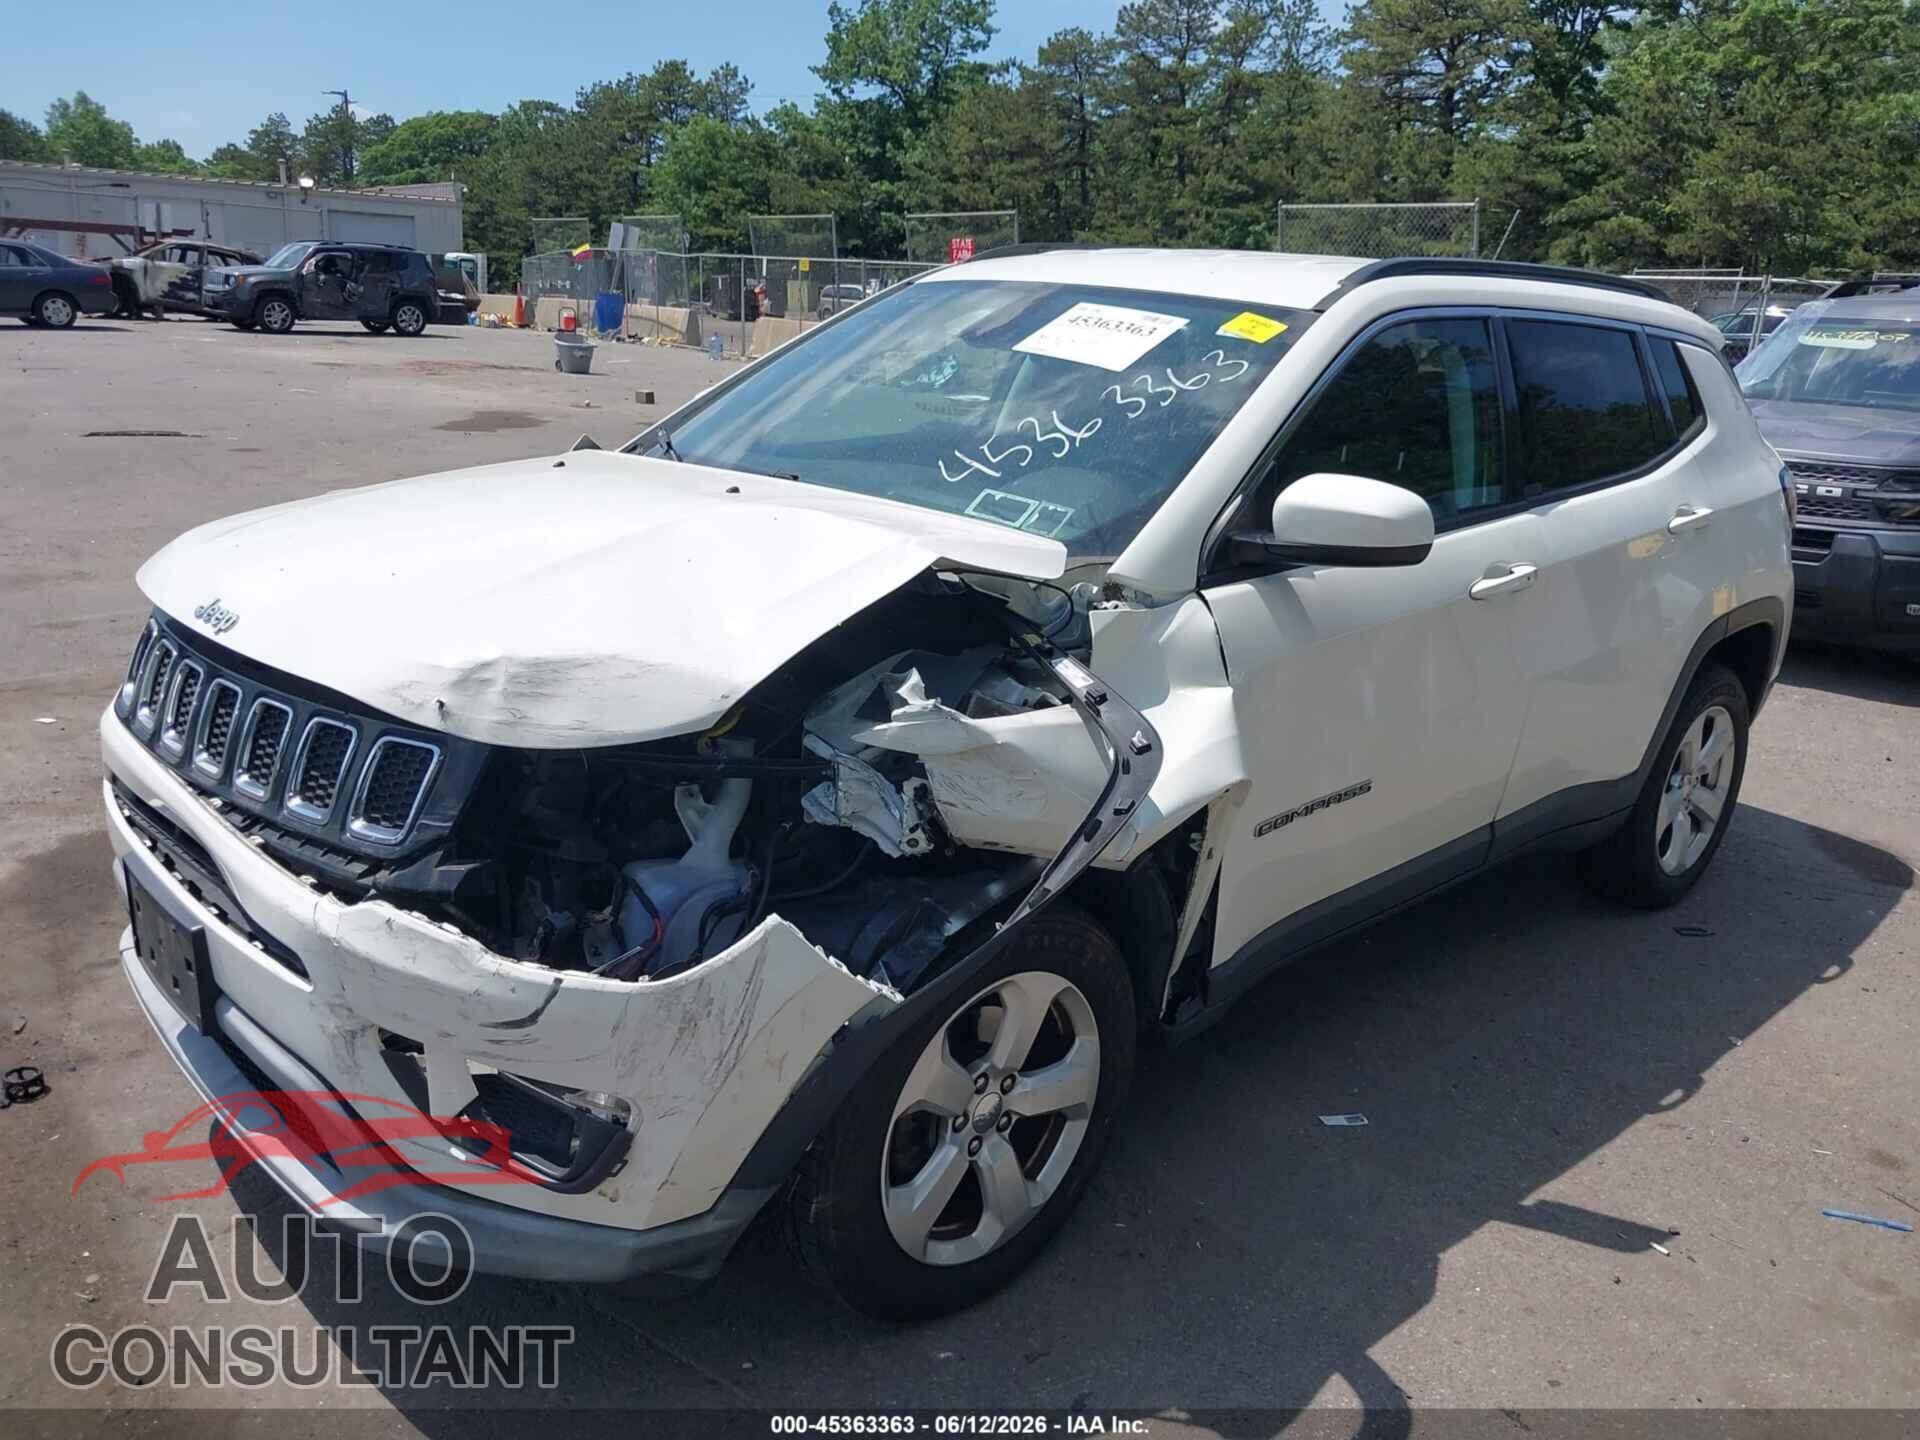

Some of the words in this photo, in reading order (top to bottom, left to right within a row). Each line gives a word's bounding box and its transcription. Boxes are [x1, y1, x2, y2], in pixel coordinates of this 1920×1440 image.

[1067, 314, 1159, 338] 45363363
[194, 598, 241, 636] Jeep
[1253, 778, 1373, 838] COMPASS
